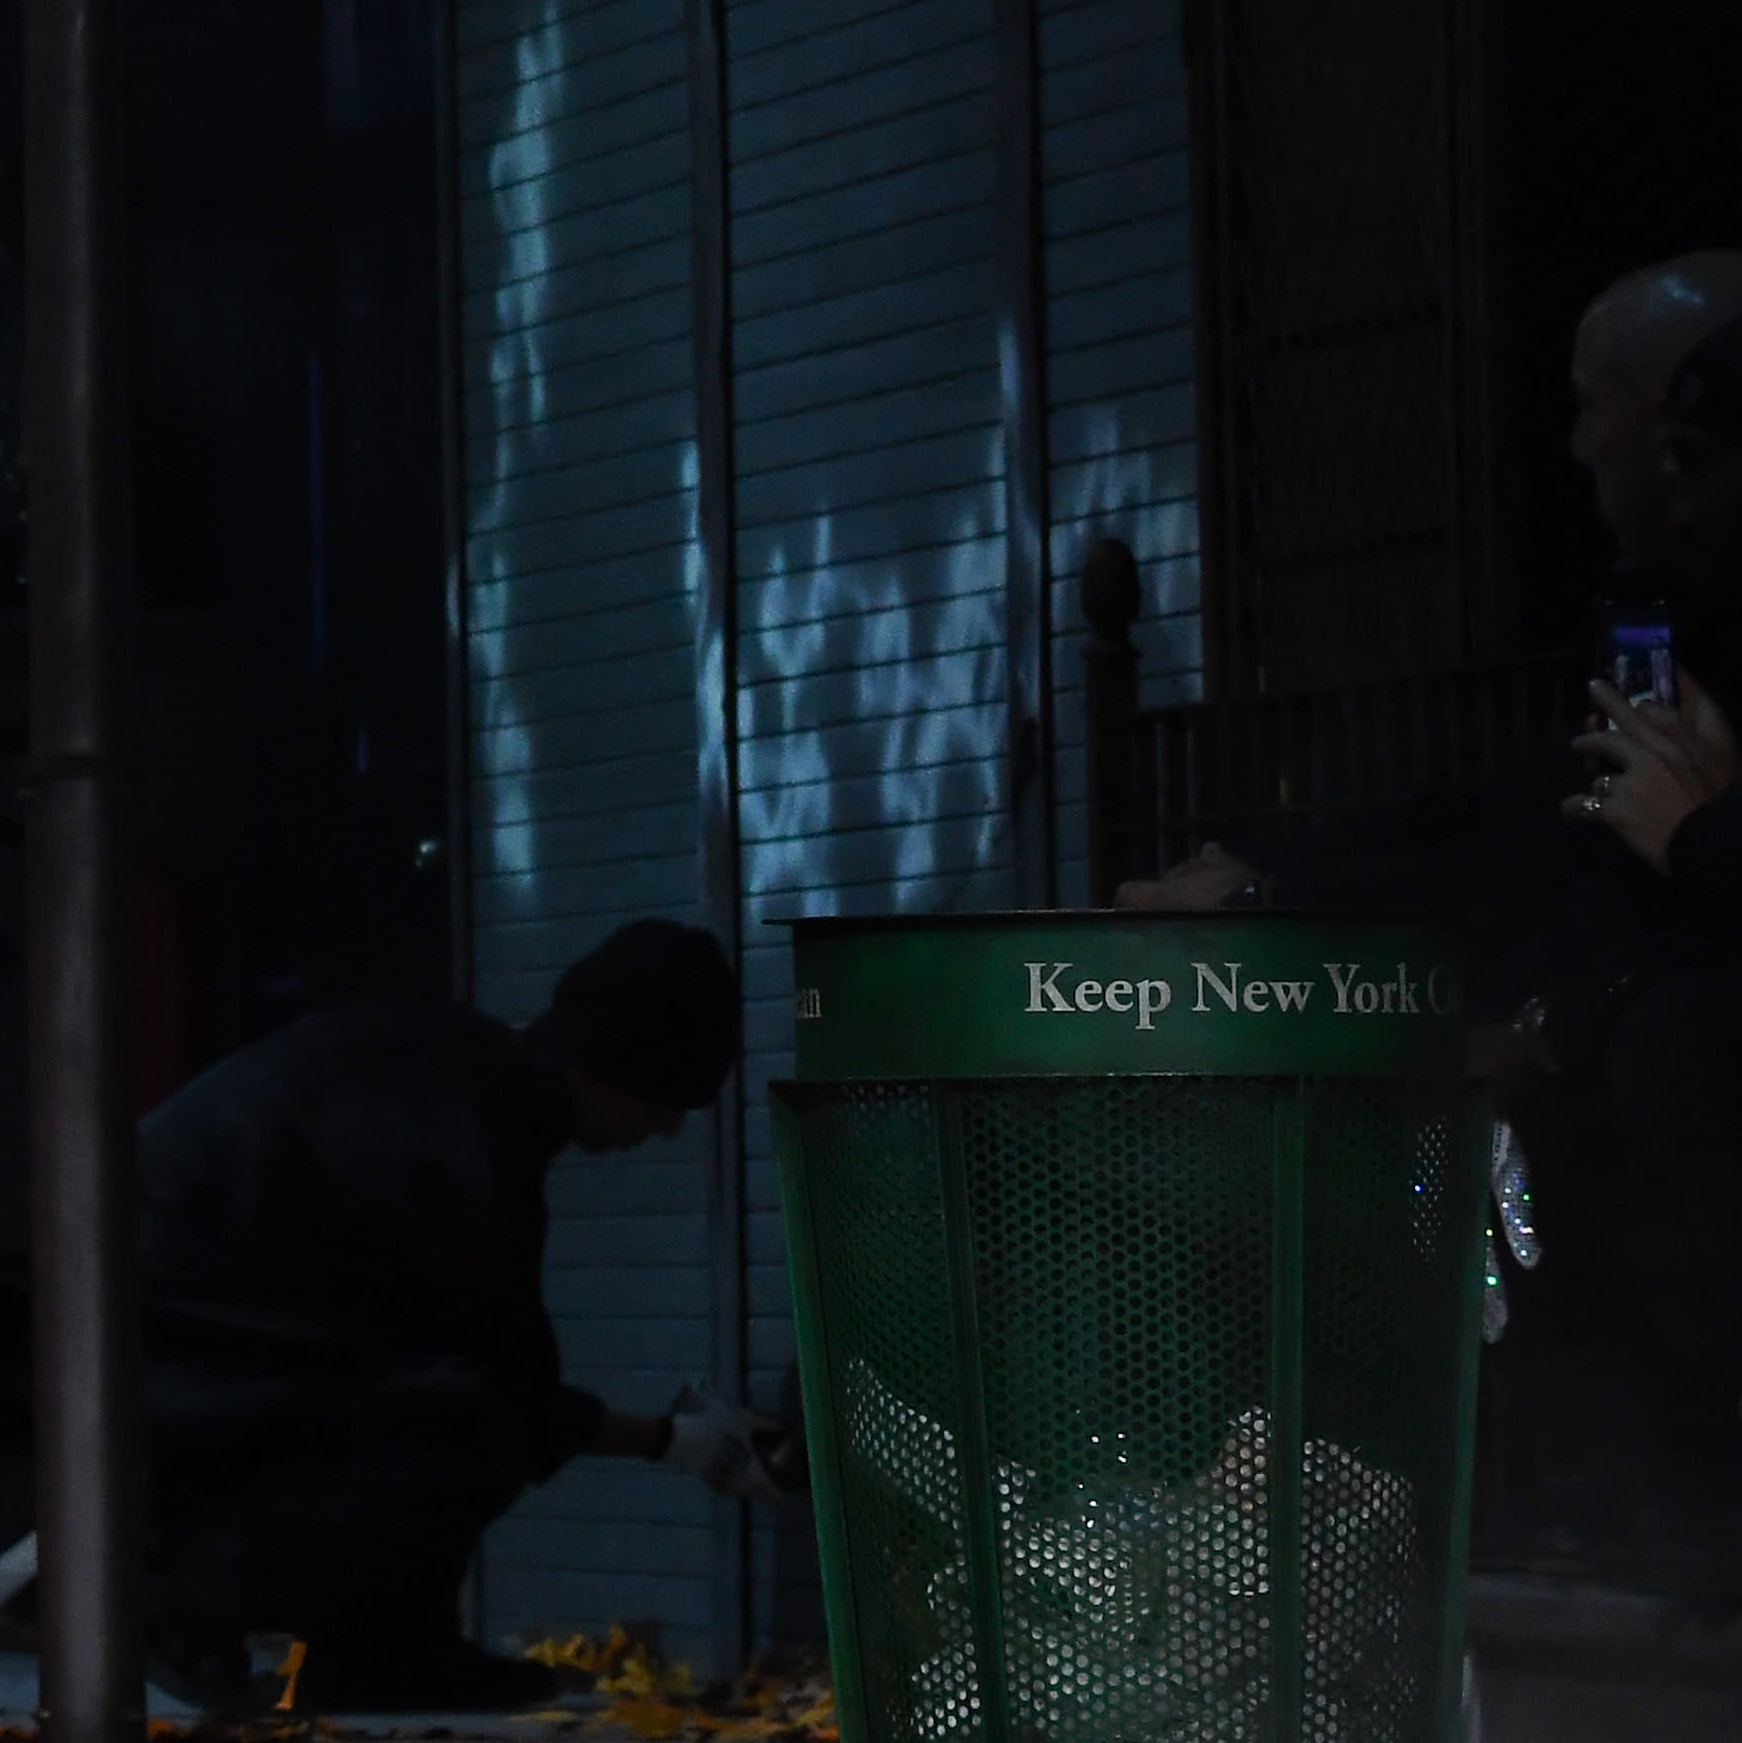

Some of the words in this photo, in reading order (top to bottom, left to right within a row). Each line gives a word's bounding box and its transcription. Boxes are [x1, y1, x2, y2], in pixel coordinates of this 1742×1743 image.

[1022, 961, 1173, 1031] Keep
[1190, 961, 1315, 1013] New
[1322, 961, 1421, 1015] York
